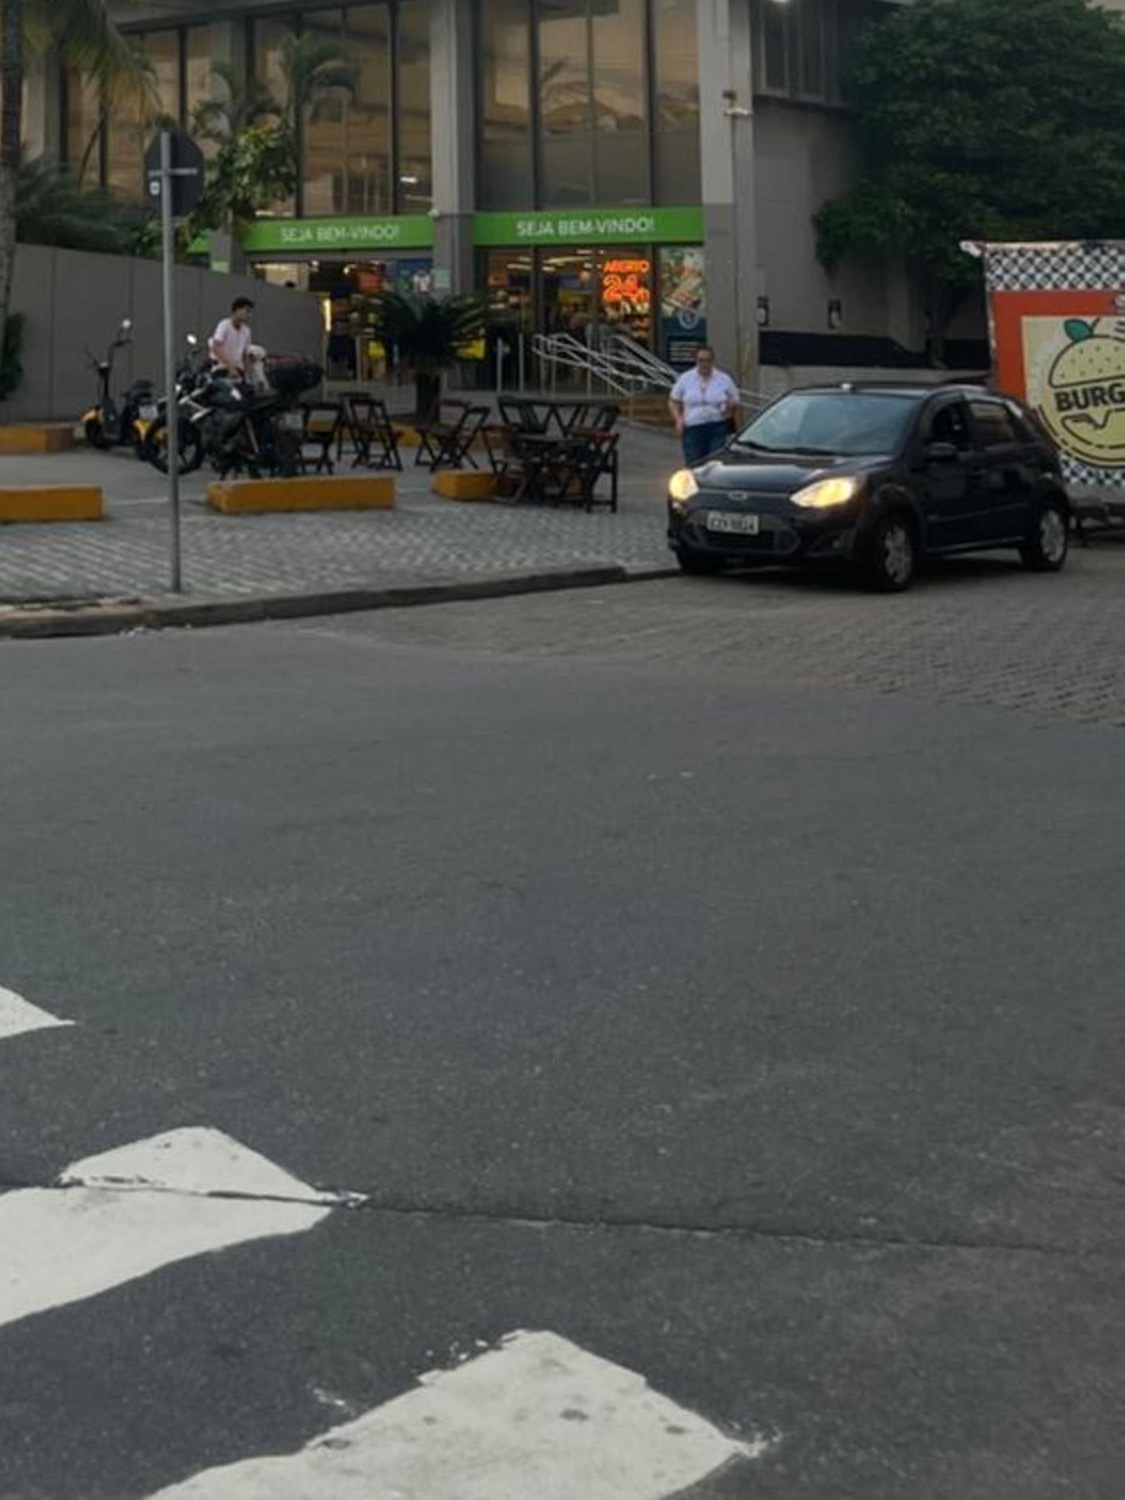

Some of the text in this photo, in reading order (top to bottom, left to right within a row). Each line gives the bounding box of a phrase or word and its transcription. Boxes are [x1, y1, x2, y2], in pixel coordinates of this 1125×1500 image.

[282, 224, 400, 243] SEJA BEM-VINDO!
[516, 216, 655, 237] SEJA BEM-VINDO!
